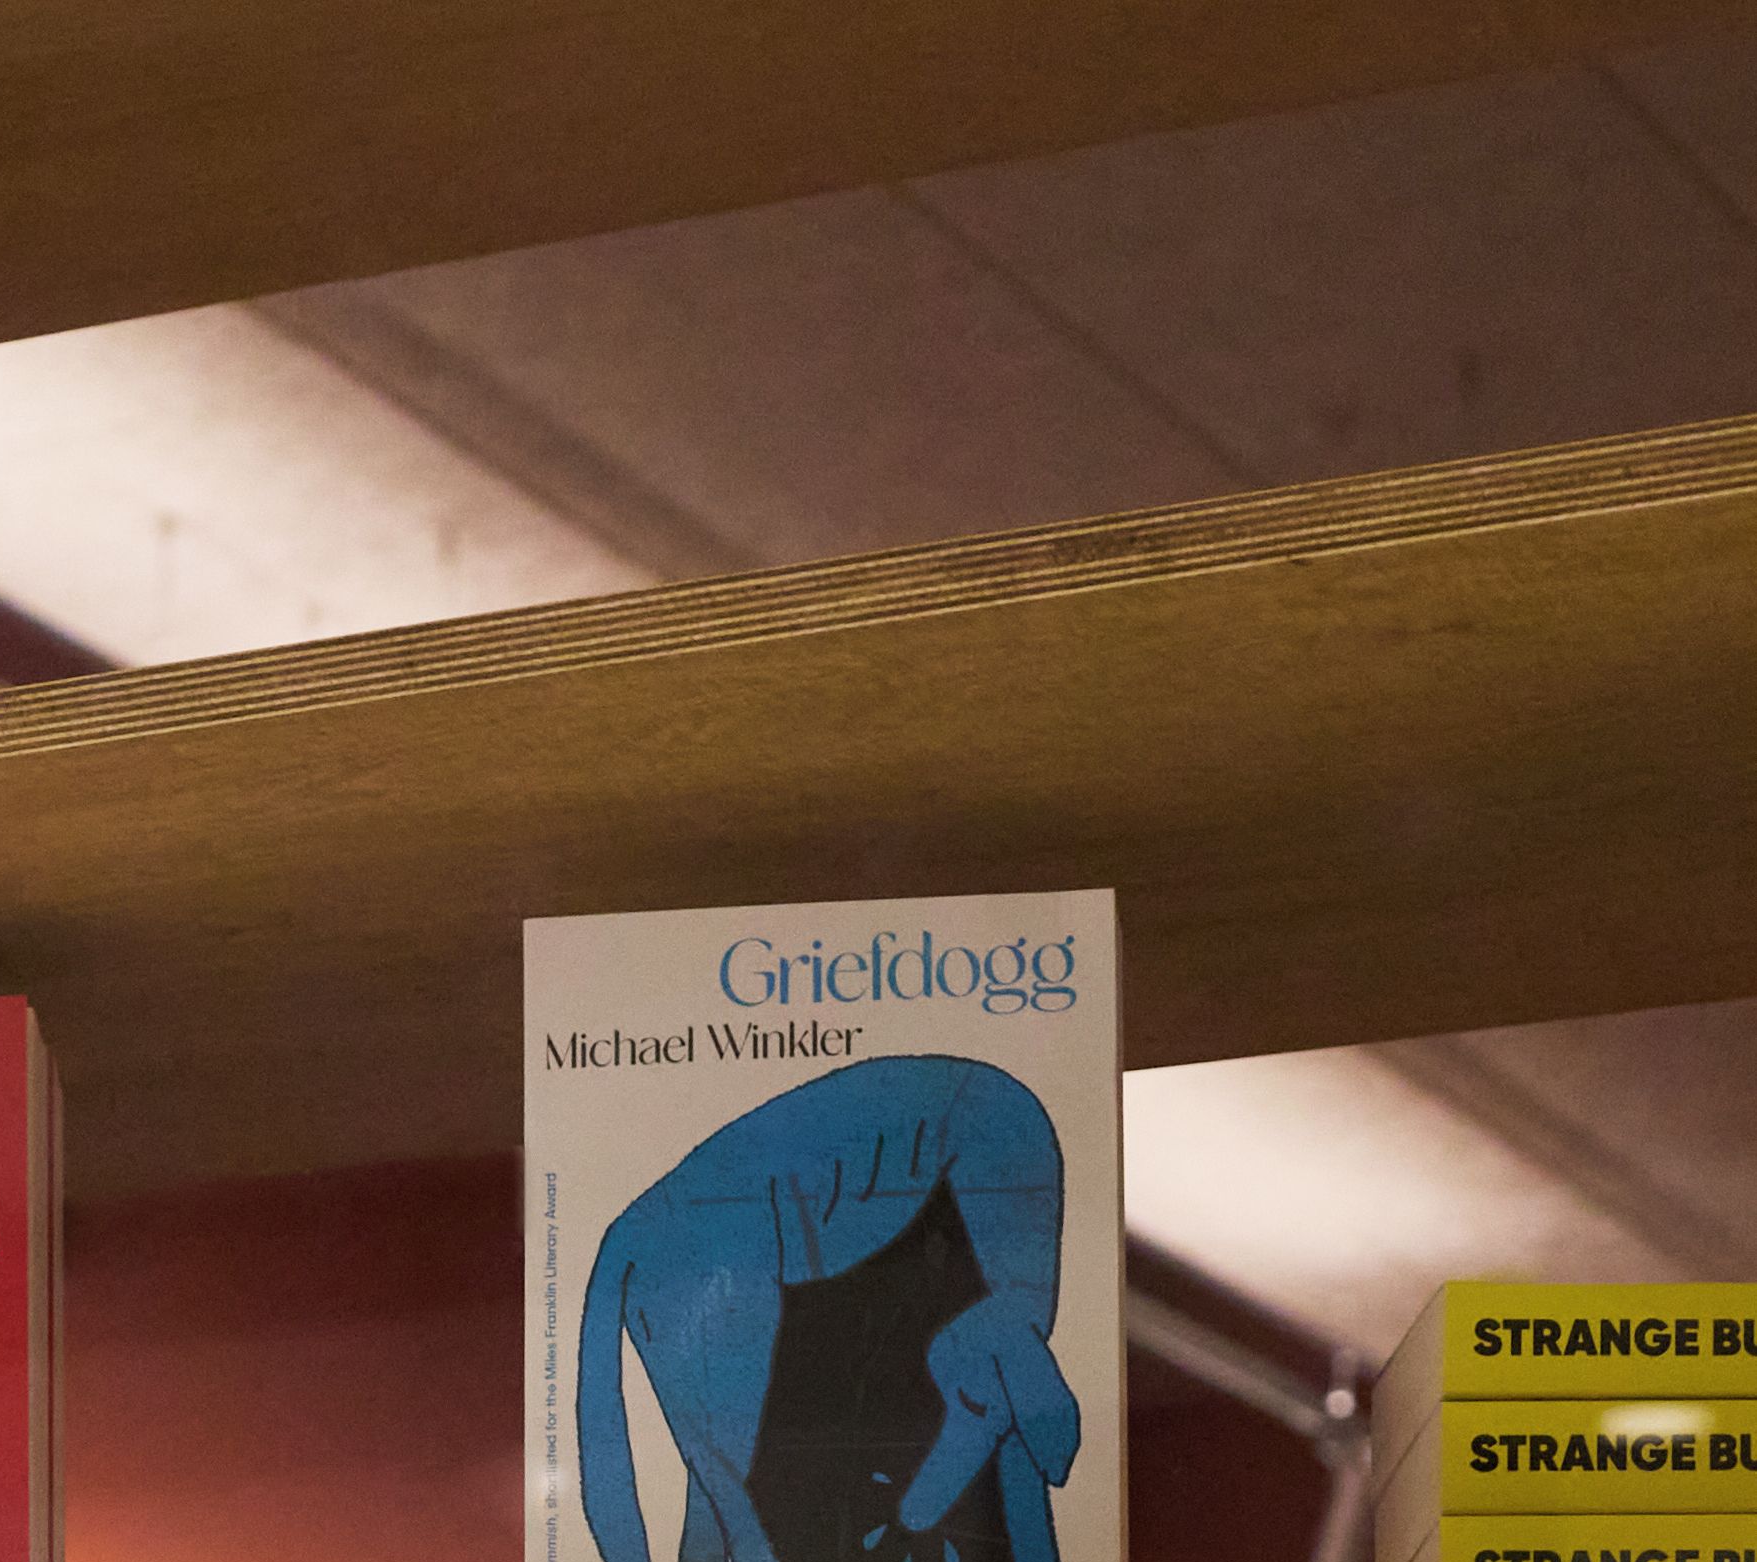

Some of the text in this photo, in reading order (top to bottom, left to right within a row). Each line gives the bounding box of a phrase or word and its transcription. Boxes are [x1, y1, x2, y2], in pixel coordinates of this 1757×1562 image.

[719, 930, 1077, 1014] Griefdogg
[546, 1020, 863, 1070] Michael Winkler
[545, 1173, 557, 1220] Award
[545, 1224, 559, 1278] Literary
[545, 1282, 557, 1338] Franklin
[1474, 1318, 1700, 1357] STRANGE
[545, 1343, 557, 1380] Miles
[546, 1383, 557, 1407] the
[545, 1411, 557, 1432] for
[545, 1434, 557, 1509] shortlisted
[1470, 1434, 1696, 1472] STRANGE
